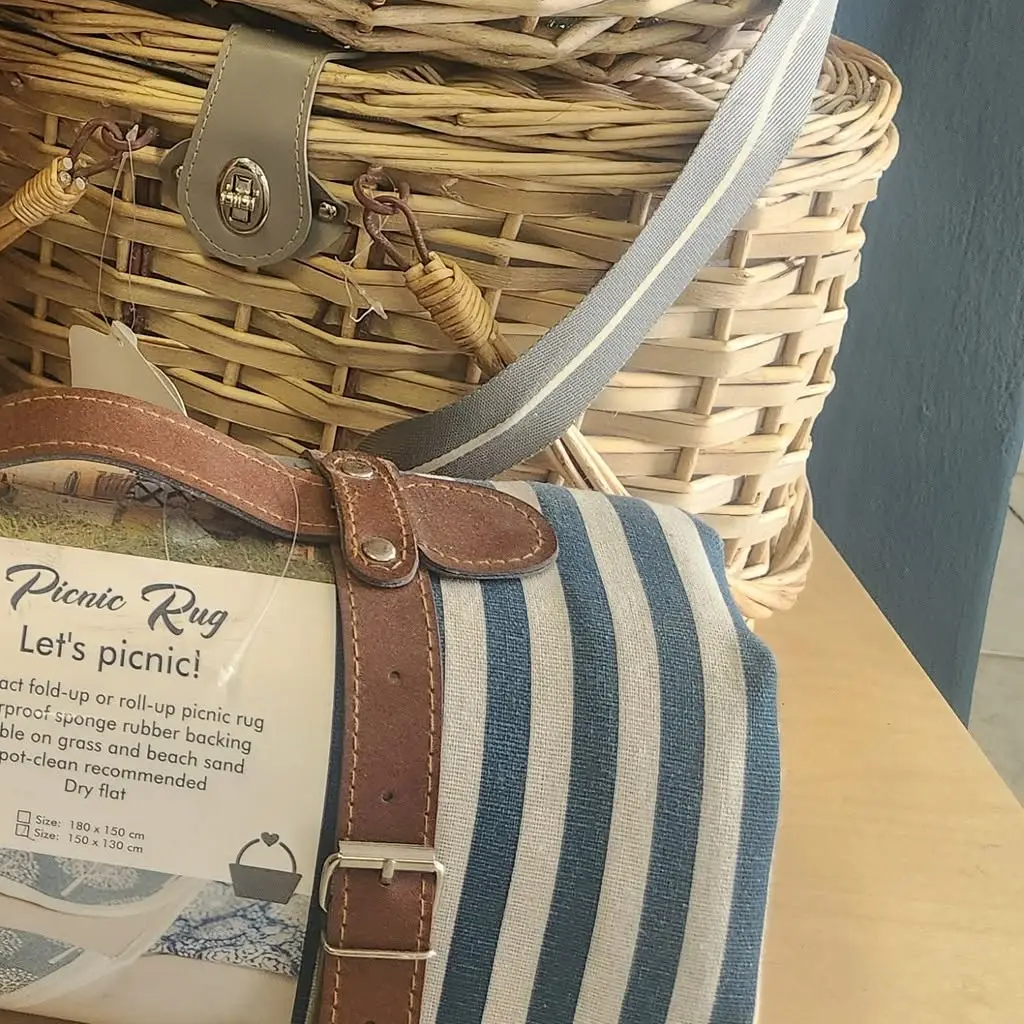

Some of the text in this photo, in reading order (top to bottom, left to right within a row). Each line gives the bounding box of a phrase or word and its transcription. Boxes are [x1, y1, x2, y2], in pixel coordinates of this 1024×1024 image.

[5, 563, 229, 639] Picnic Rug
[19, 625, 201, 678] Let's picnic!
[29, 678, 90, 705] fold-up
[95, 693, 114, 705] or
[119, 694, 176, 718] roll-up
[181, 704, 231, 724] picnic
[236, 714, 264, 733] rug
[30, 733, 52, 744] on
[58, 736, 102, 752] grass
[108, 743, 140, 758] and
[147, 744, 198, 766] beach
[203, 758, 245, 774] sand
[55, 711, 117, 733] sponge
[123, 719, 180, 740] rubber
[185, 726, 252, 755] backing
[64, 778, 126, 801] Dry flat
[84, 762, 207, 791] recommended
[34, 828, 143, 853] Size: 150 x 130 cm
[36, 815, 61, 827] Size:
[70, 820, 91, 832] 180
[105, 825, 126, 837] 150
[128, 831, 145, 840] cm
